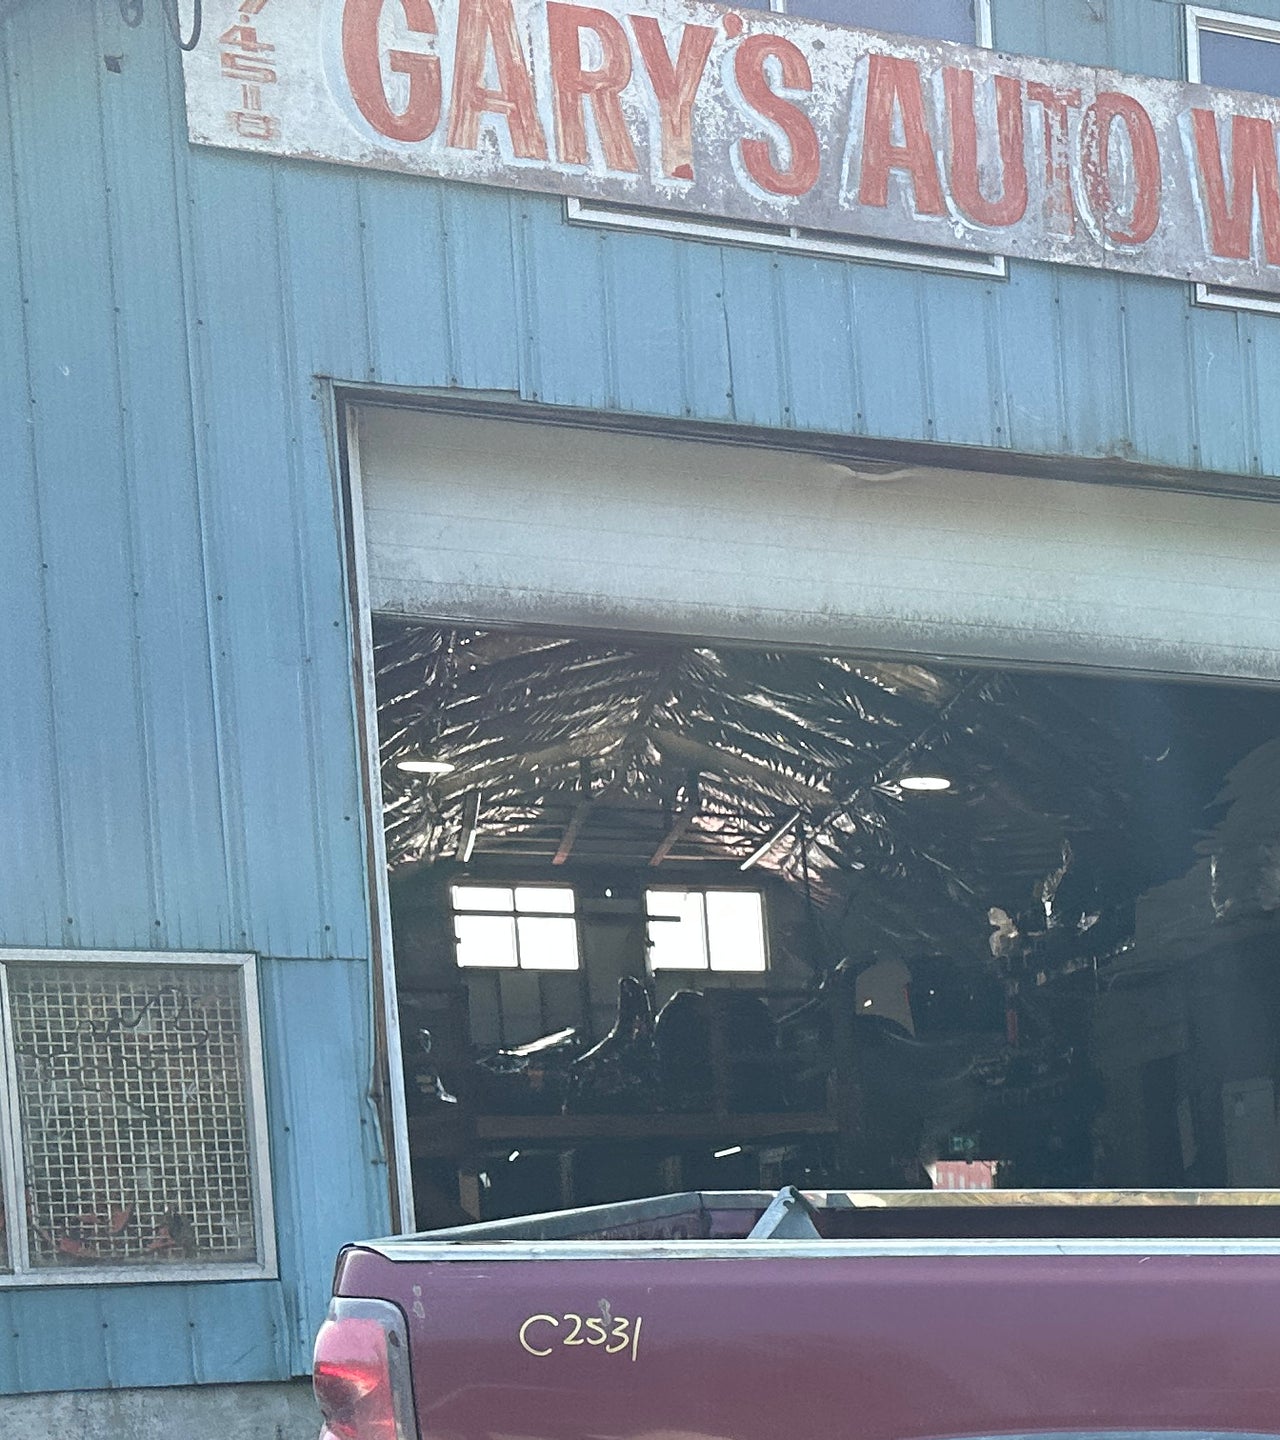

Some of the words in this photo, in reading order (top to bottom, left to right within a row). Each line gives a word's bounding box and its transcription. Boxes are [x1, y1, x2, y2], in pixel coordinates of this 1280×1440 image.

[341, 0, 821, 197] GARY'S
[858, 53, 1161, 247] AUTO
[519, 1313, 642, 1361] C2531
